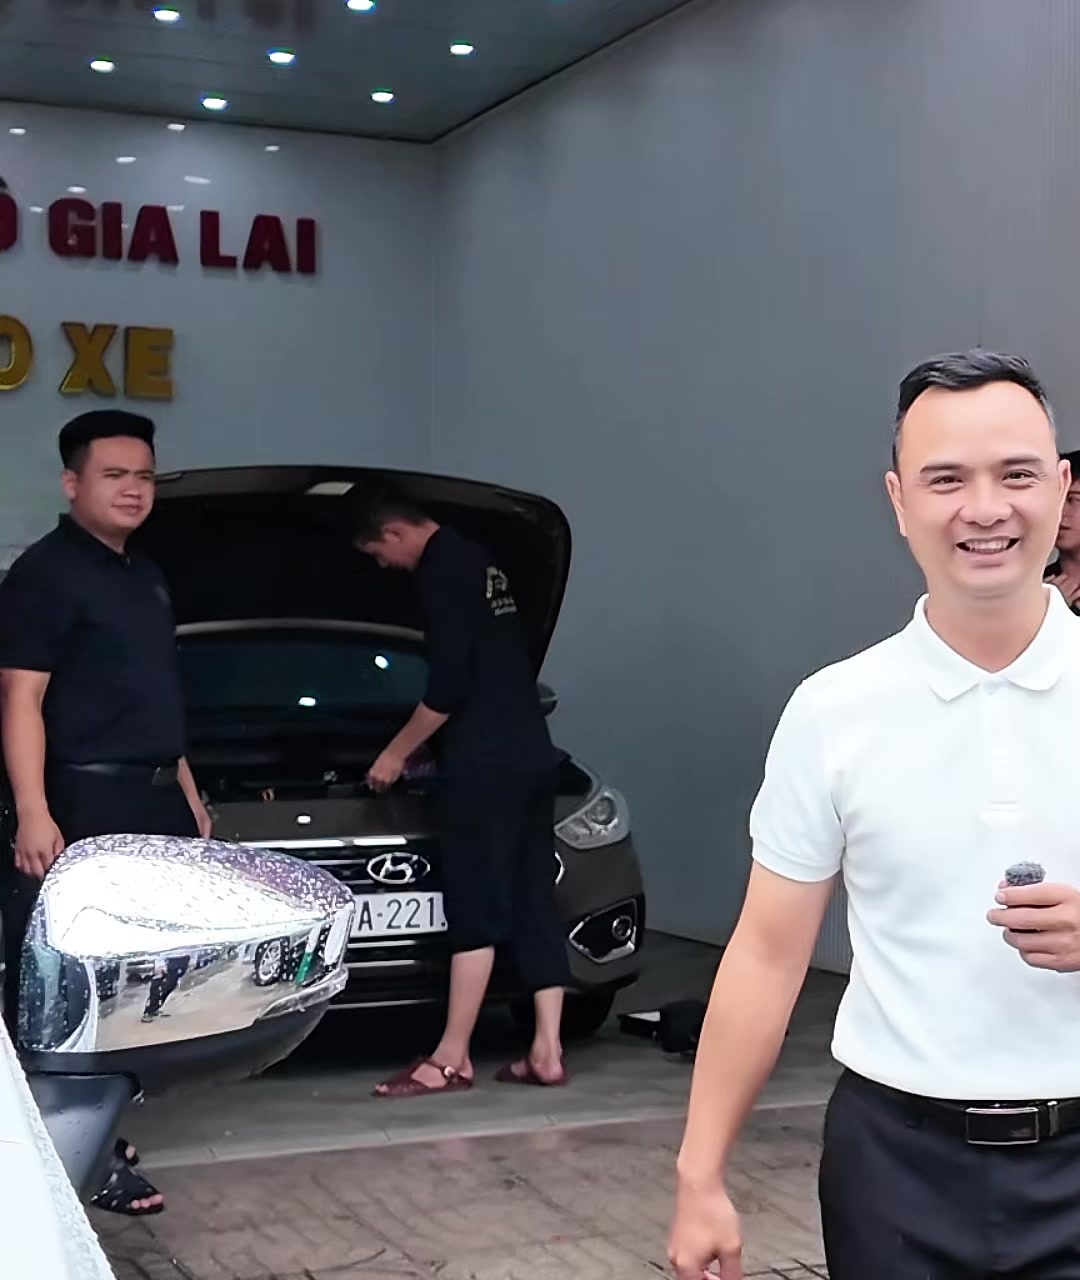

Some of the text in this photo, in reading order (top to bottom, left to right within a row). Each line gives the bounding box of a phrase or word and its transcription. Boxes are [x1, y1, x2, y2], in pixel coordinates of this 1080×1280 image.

[48, 197, 179, 265] GIA
[200, 210, 316, 275] LAI
[59, 322, 175, 401] XE
